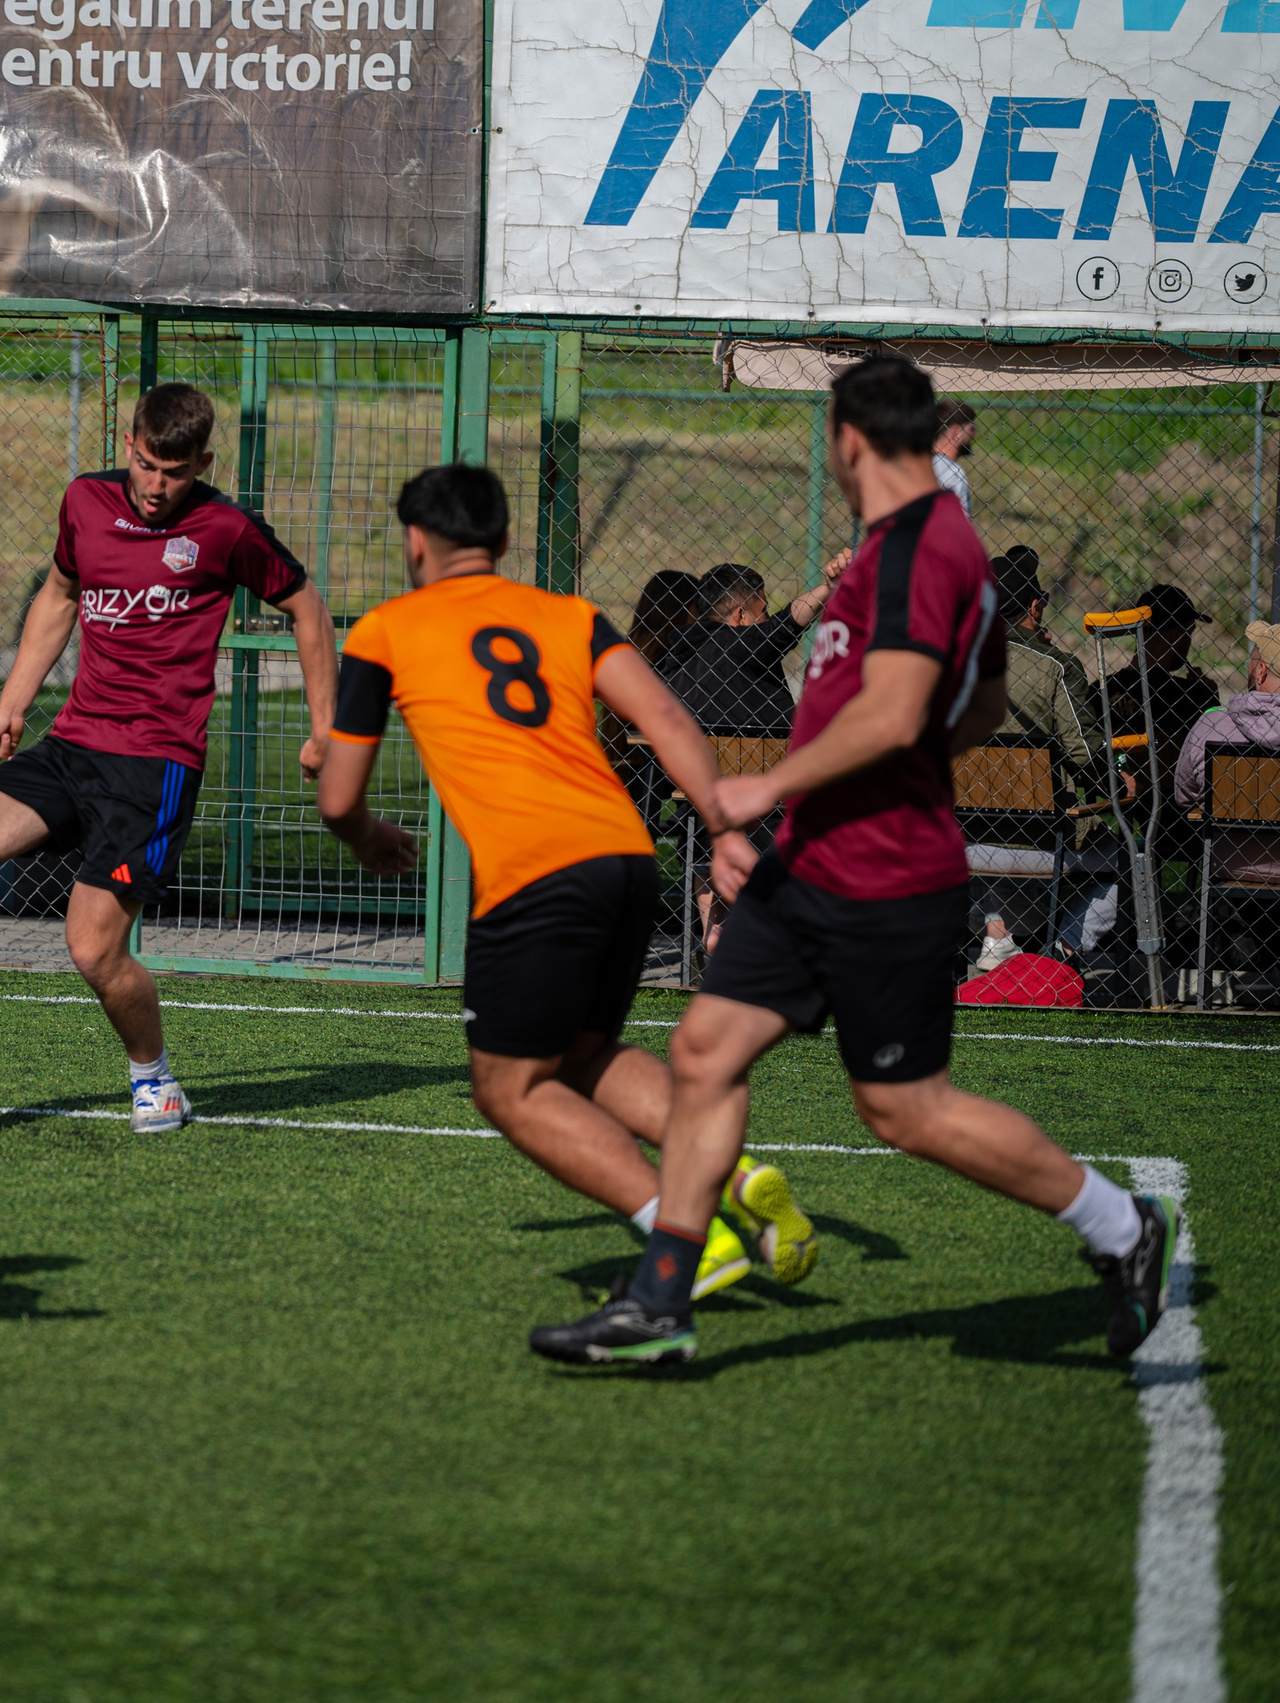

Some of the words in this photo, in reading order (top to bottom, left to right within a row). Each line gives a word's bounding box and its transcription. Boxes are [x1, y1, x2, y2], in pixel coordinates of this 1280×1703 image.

[230, 0, 434, 31] terenul
[176, 38, 412, 91] victorie!
[471, 626, 551, 728] 8
